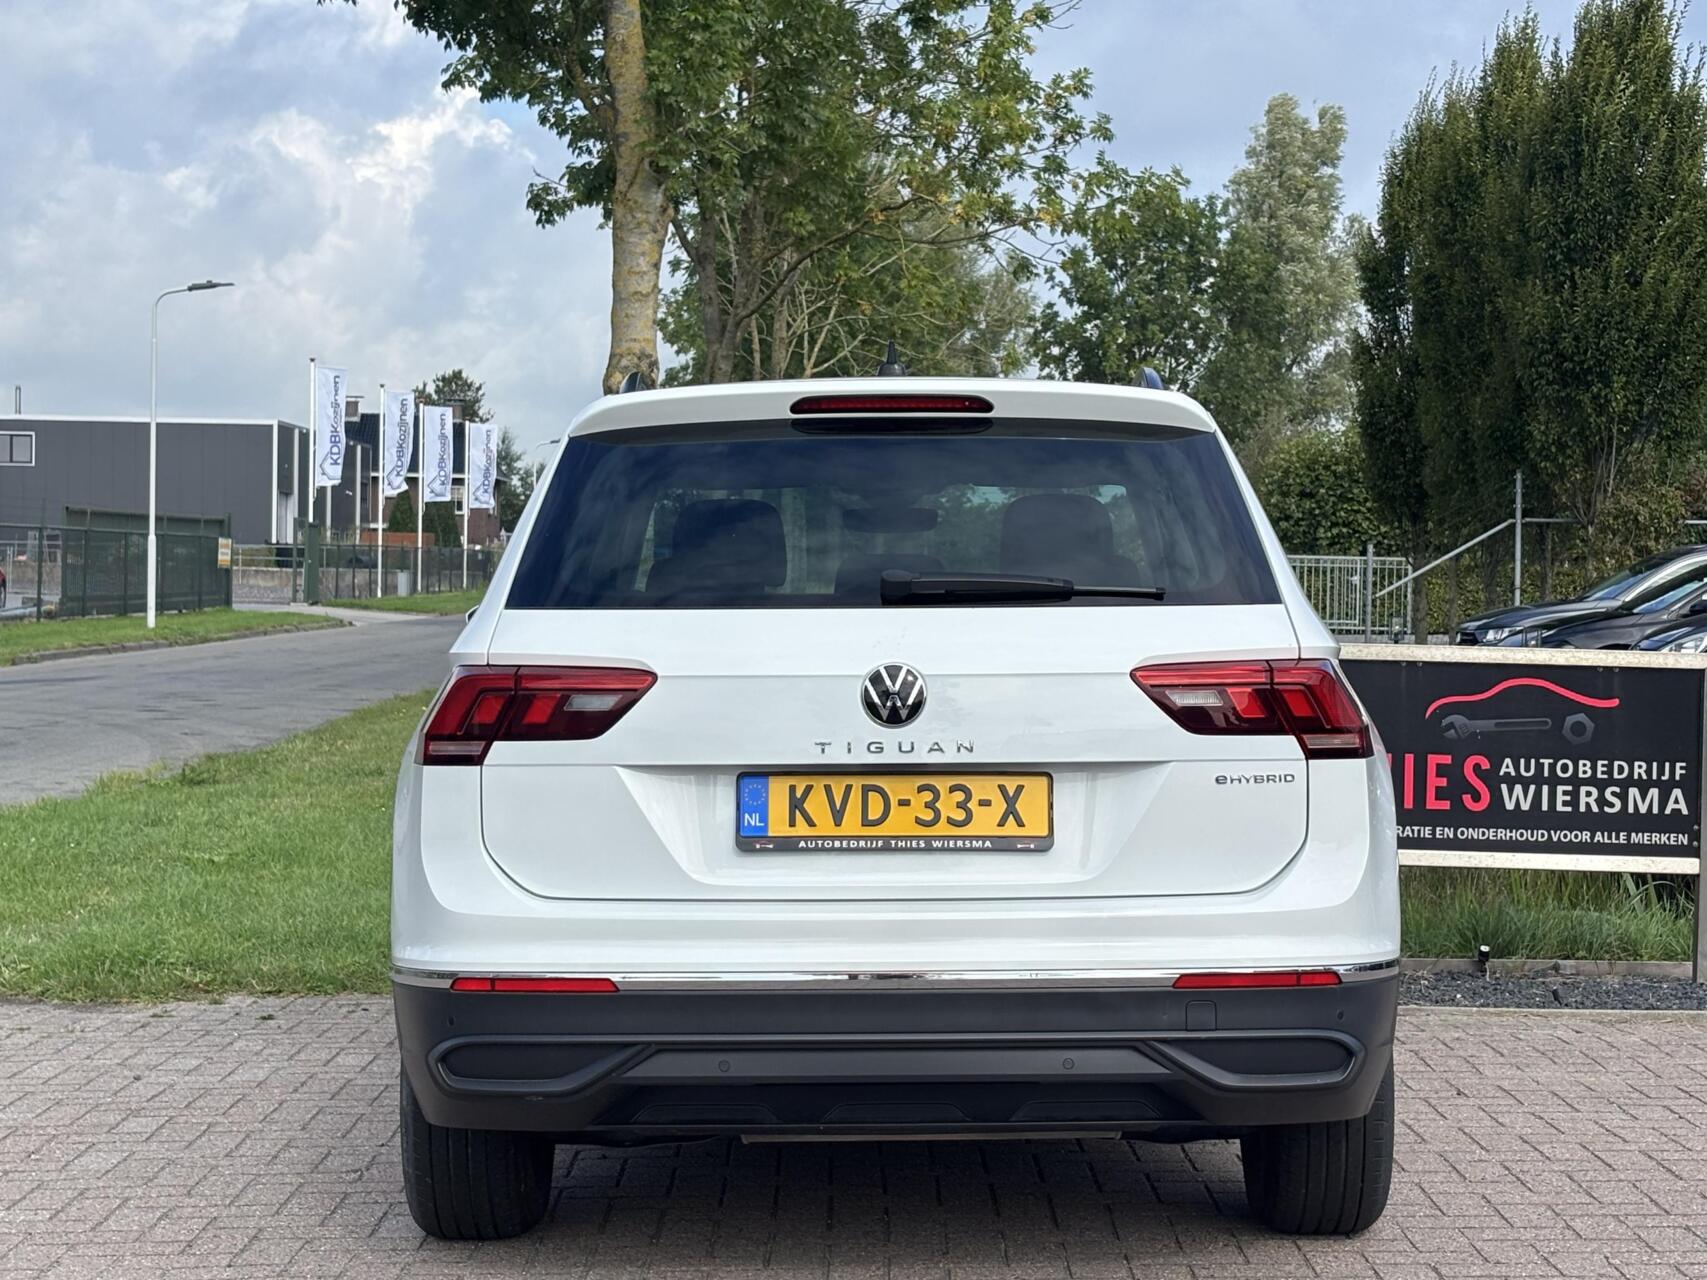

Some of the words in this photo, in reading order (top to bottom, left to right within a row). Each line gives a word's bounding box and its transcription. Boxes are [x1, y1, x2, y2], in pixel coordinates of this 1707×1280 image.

[329, 375, 341, 466] KDBKozijnen
[395, 398, 408, 477] KDBKozijnen
[438, 413, 448, 486] KDBKozijnen
[814, 740, 974, 754] TIGUAN
[1215, 774, 1295, 785] eHYBRID
[1387, 753, 1491, 812] IES
[1499, 757, 1687, 781] AUTOBEDRIJF
[788, 784, 1026, 828] KVD-33-X
[1500, 783, 1689, 815] WIERSMA
[744, 813, 765, 827] NL
[798, 840, 884, 849] AUTOBEDRIJF
[889, 840, 925, 849] THIES
[931, 840, 992, 849] WIERSMA
[1435, 827, 1454, 839] EN
[1457, 827, 1548, 842] ONDERHOUD
[1550, 829, 1591, 843] VOOR
[1593, 831, 1628, 844] ALLE
[1630, 832, 1688, 846] MERKEN
